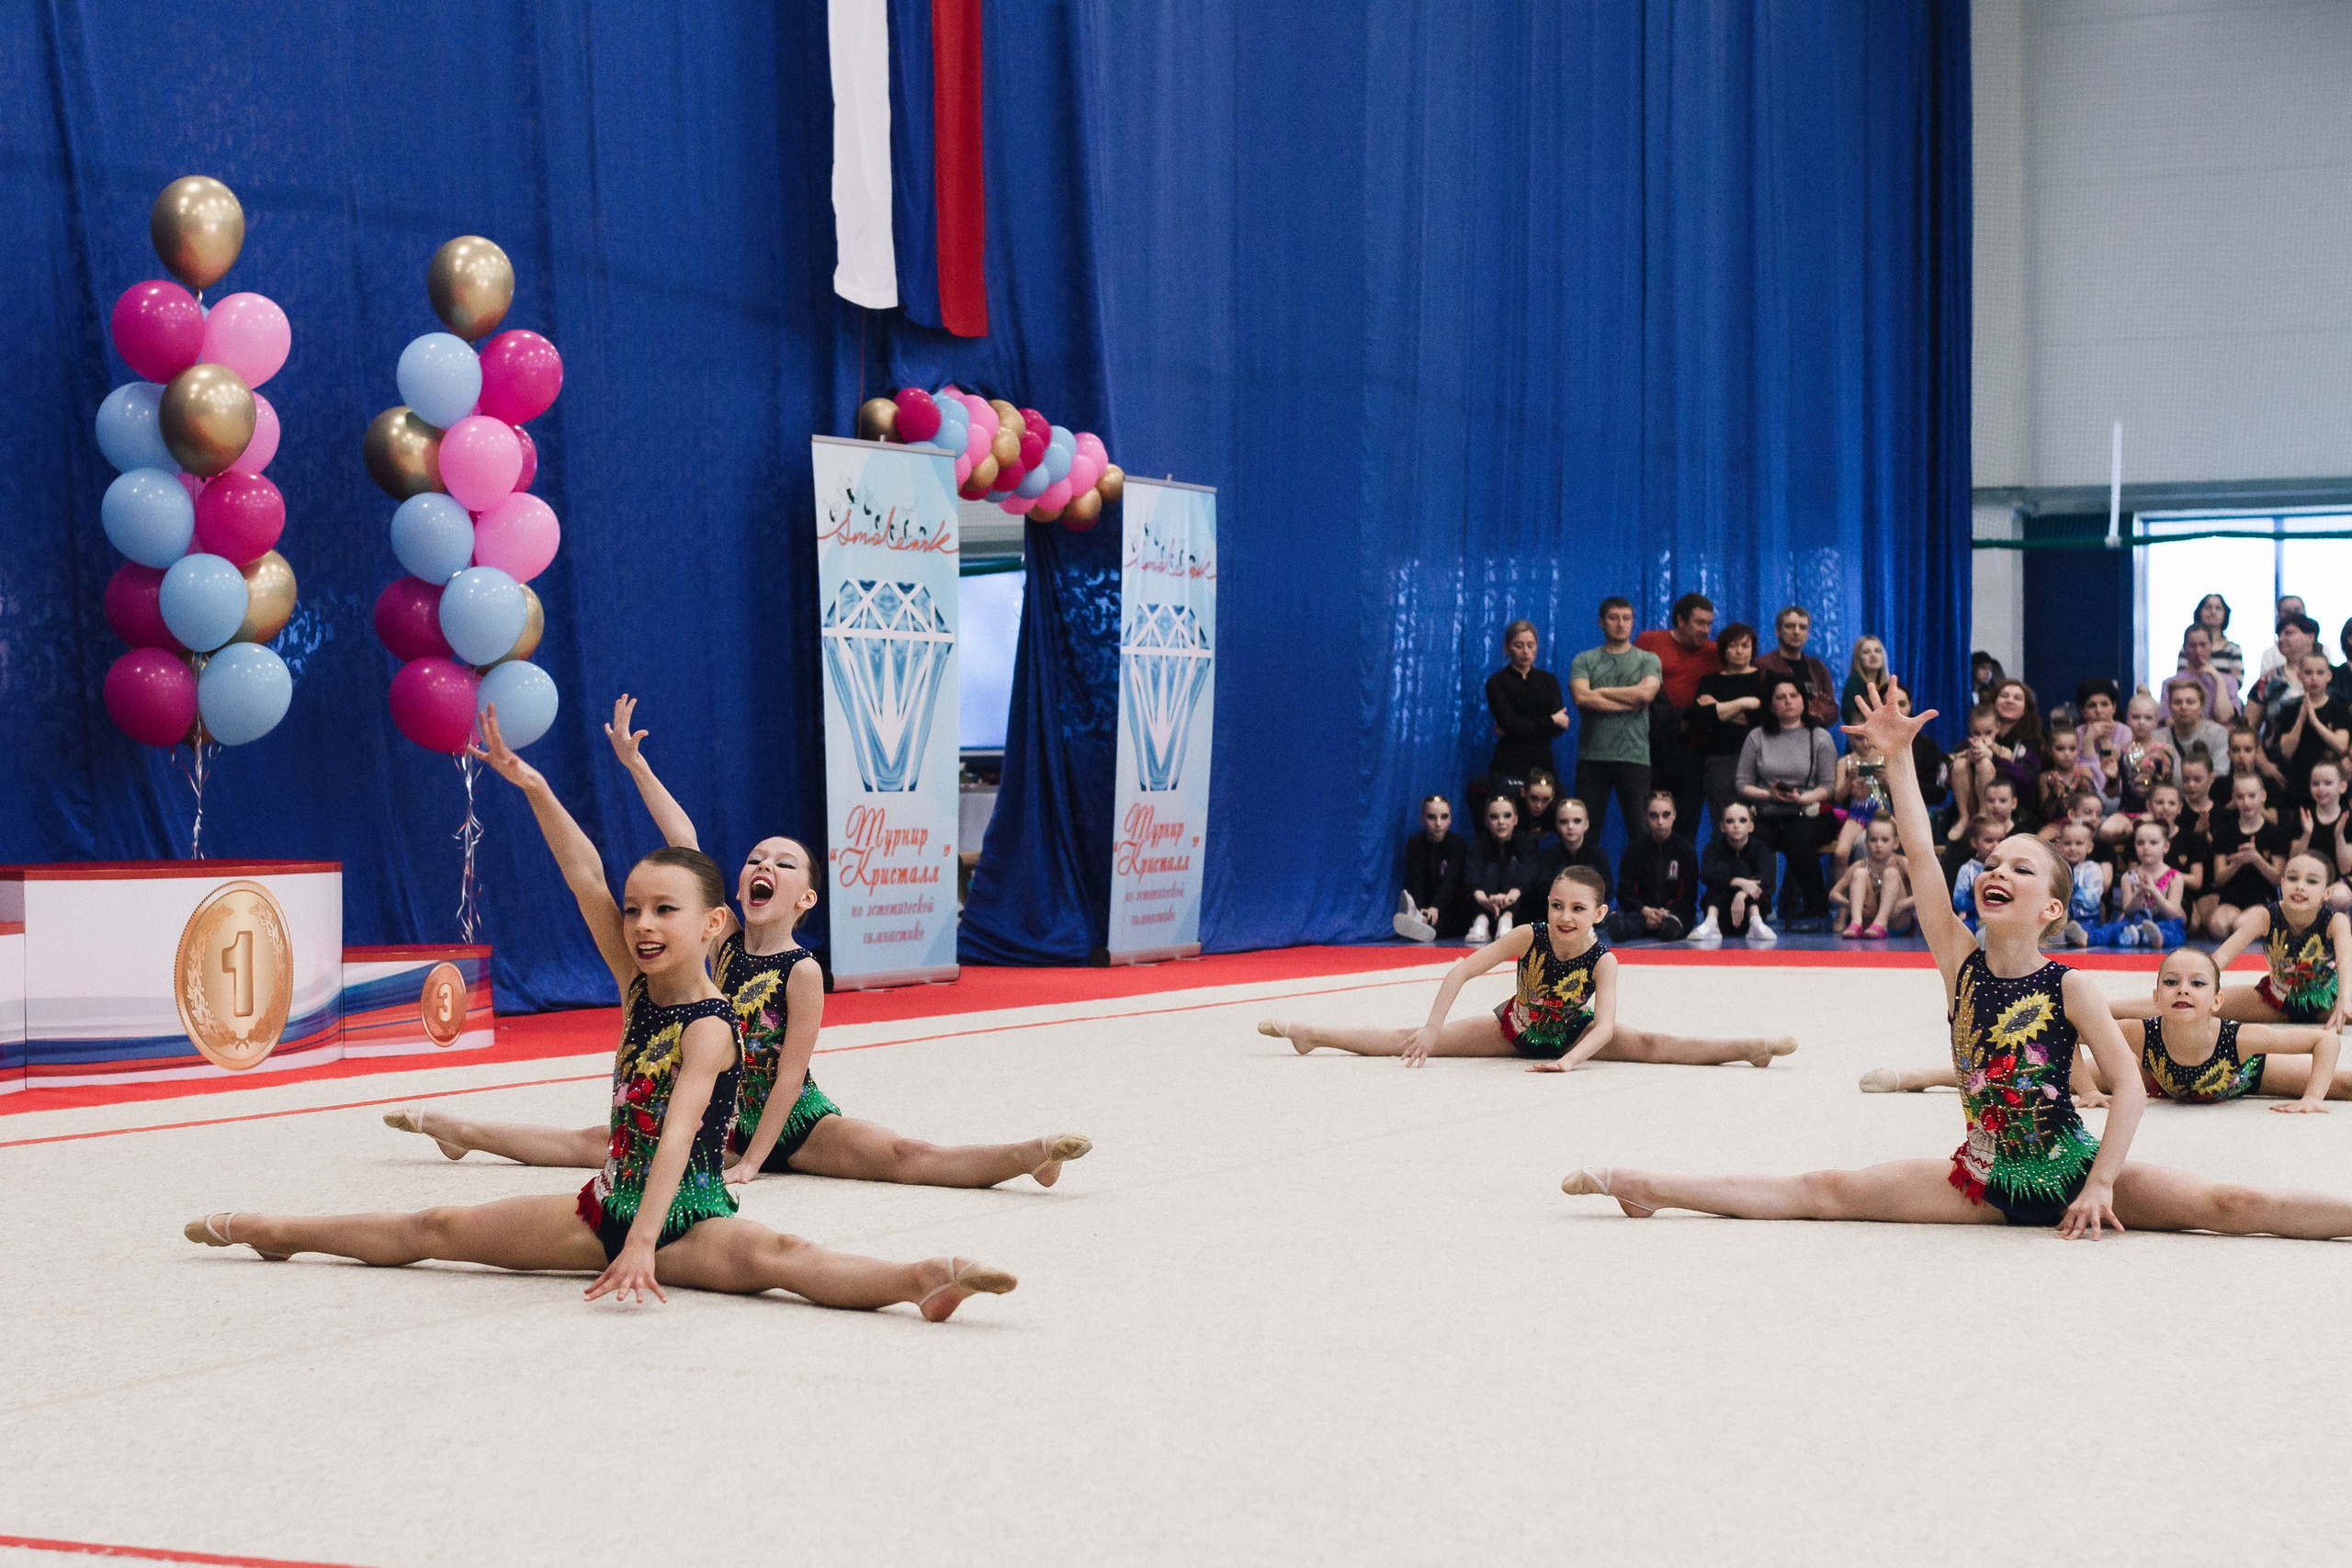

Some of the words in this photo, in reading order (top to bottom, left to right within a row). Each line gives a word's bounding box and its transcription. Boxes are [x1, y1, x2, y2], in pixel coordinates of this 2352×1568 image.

[845, 805, 928, 857] Турнир
[1124, 802, 1184, 849] Турнир
[221, 930, 254, 1018] 1
[436, 982, 454, 1021] 3
